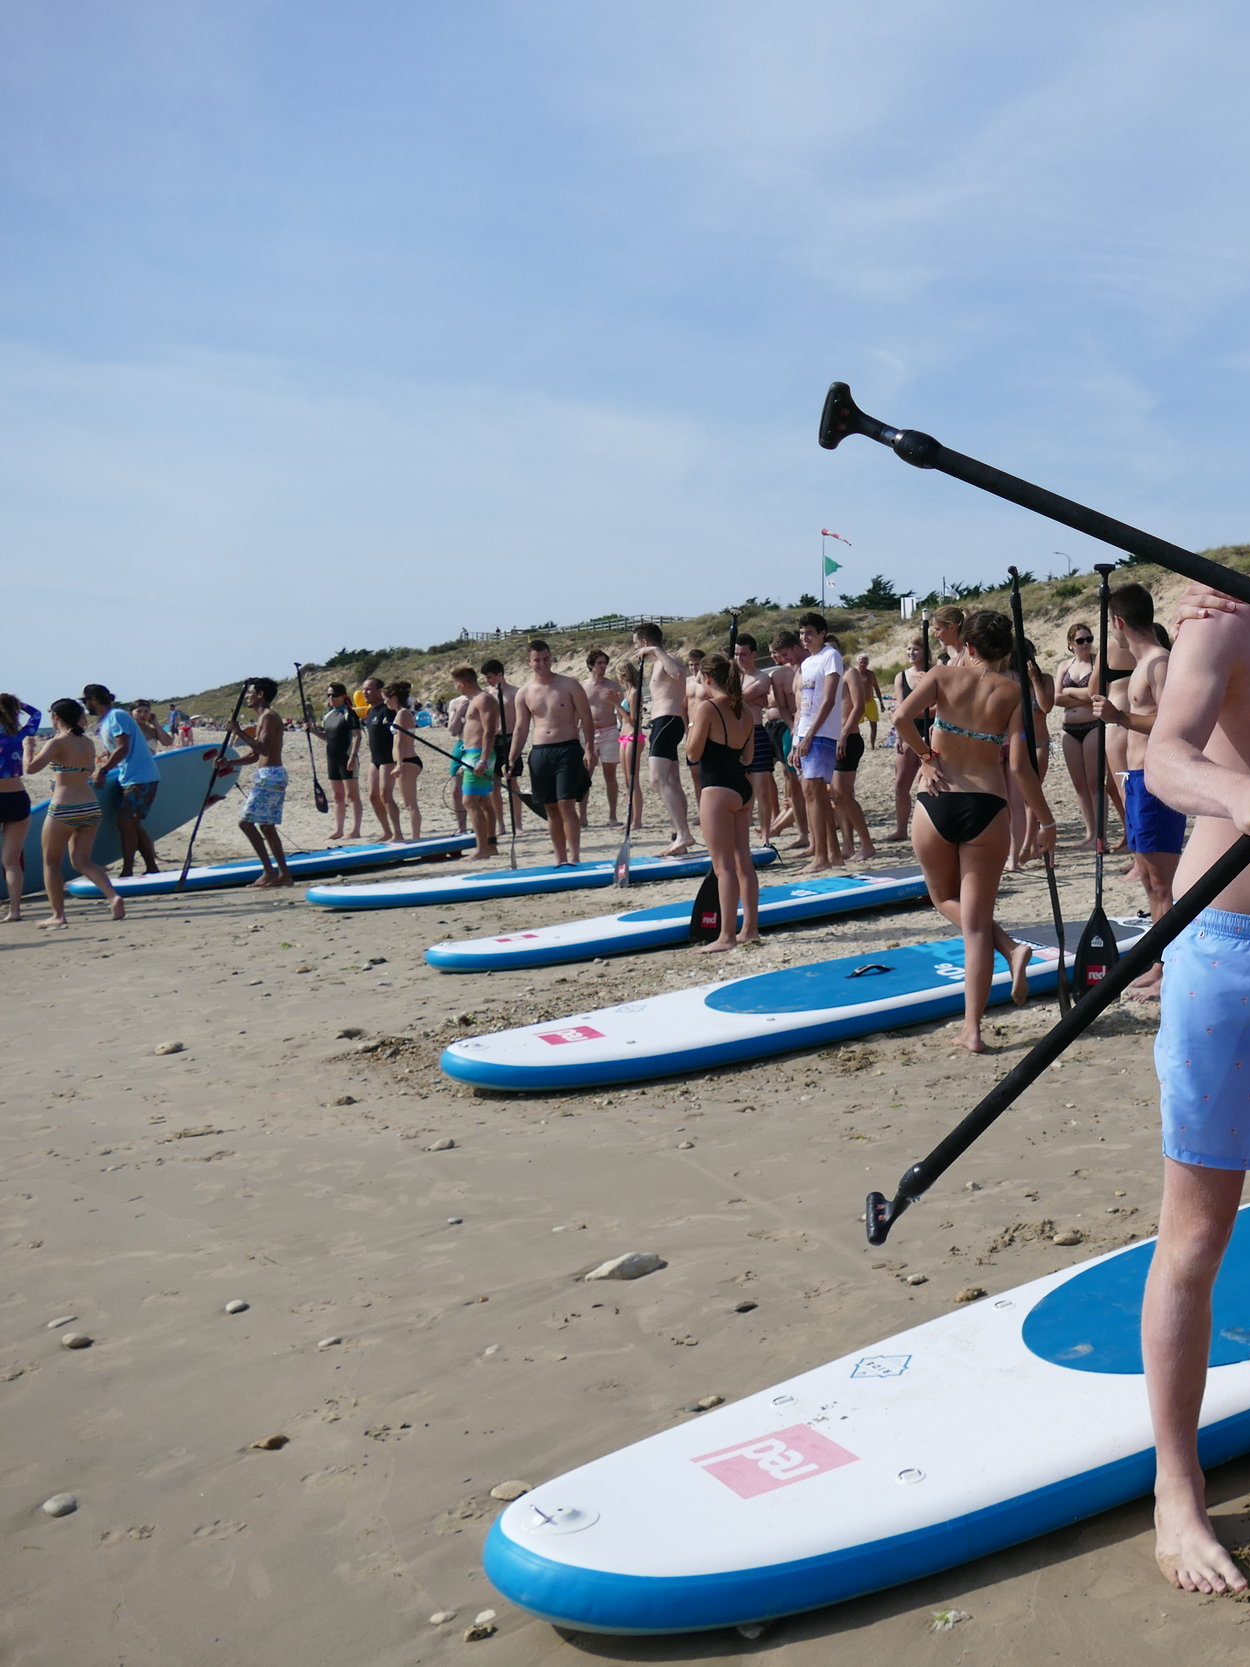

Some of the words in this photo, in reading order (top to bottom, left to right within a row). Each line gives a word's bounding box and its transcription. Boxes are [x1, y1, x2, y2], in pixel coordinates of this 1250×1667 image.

[702, 912, 717, 924] red
[1089, 966, 1106, 980] red
[695, 1438, 819, 1480] red
